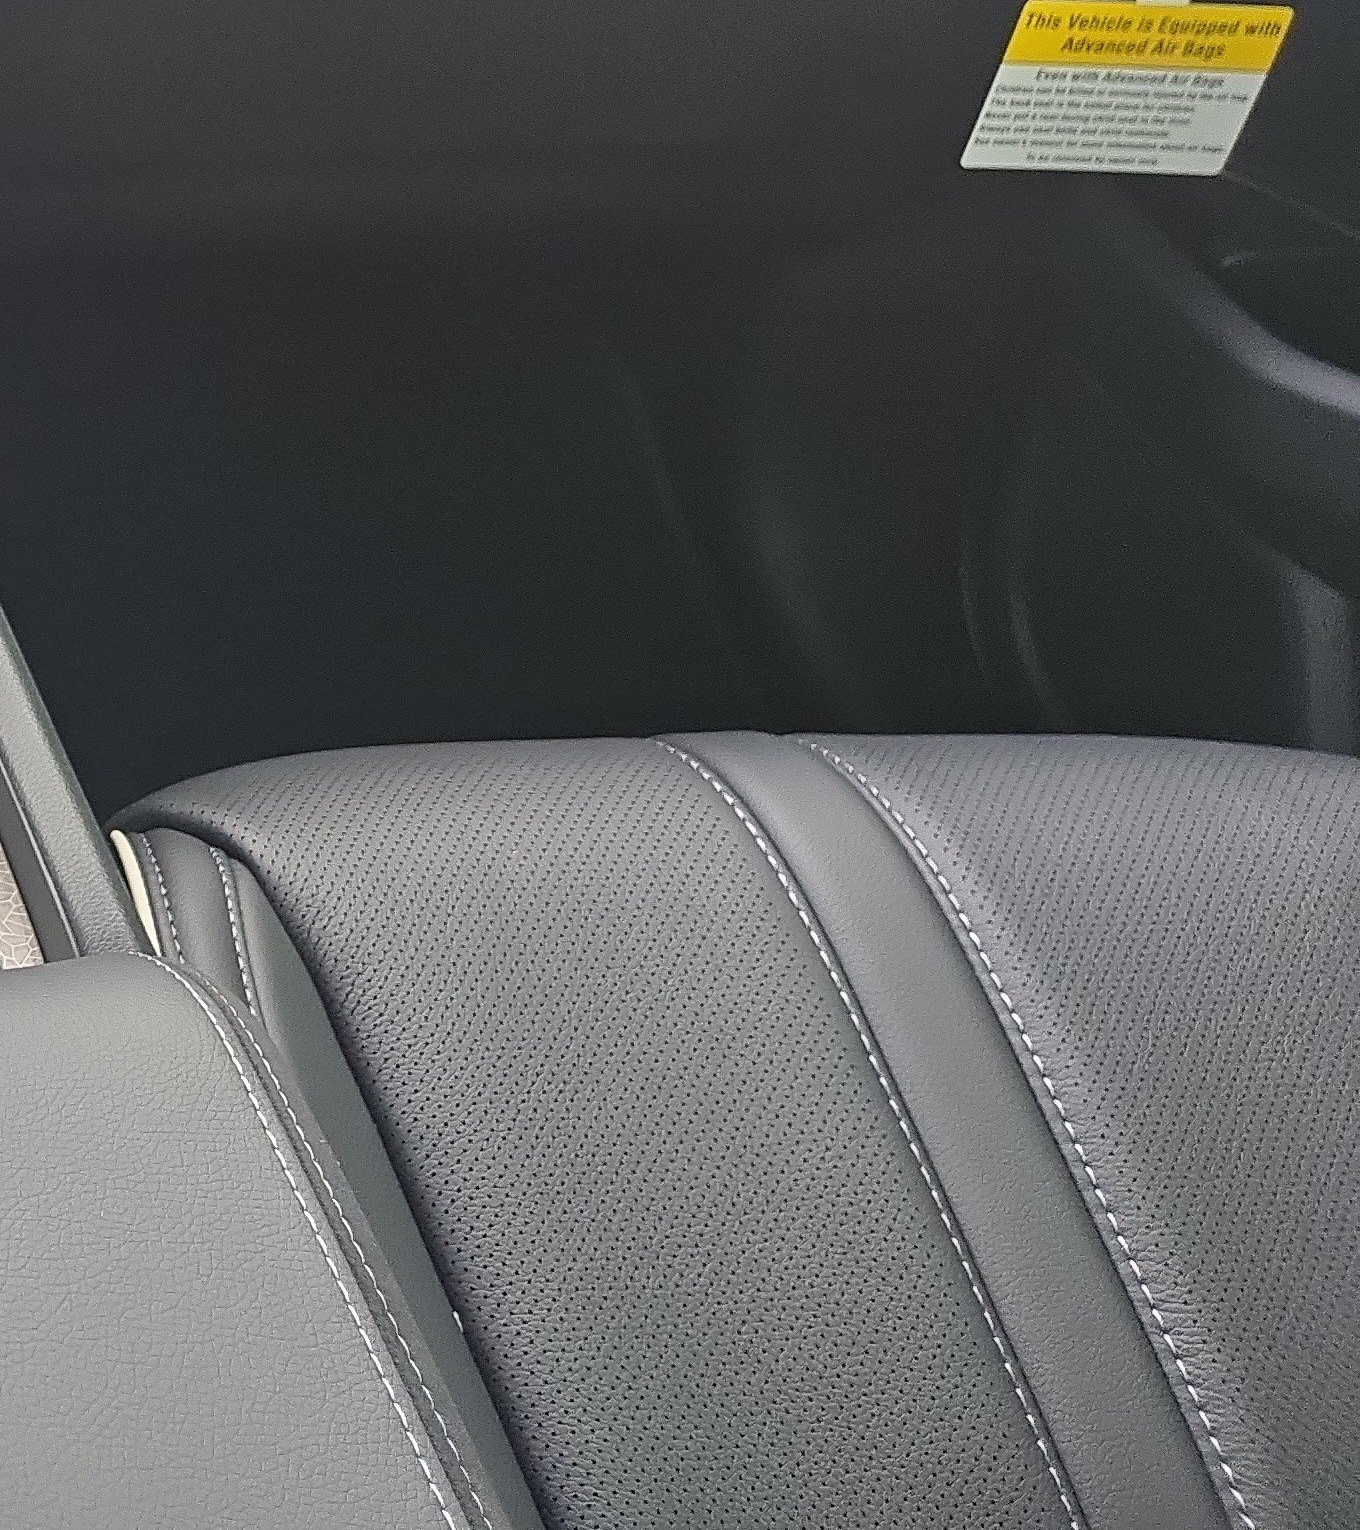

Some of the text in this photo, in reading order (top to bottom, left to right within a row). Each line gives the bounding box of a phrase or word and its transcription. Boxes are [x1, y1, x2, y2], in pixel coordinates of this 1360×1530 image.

[1024, 11, 1281, 38] This Vehicle is Equipped with
[1060, 36, 1227, 62] Advanced Air Bags
